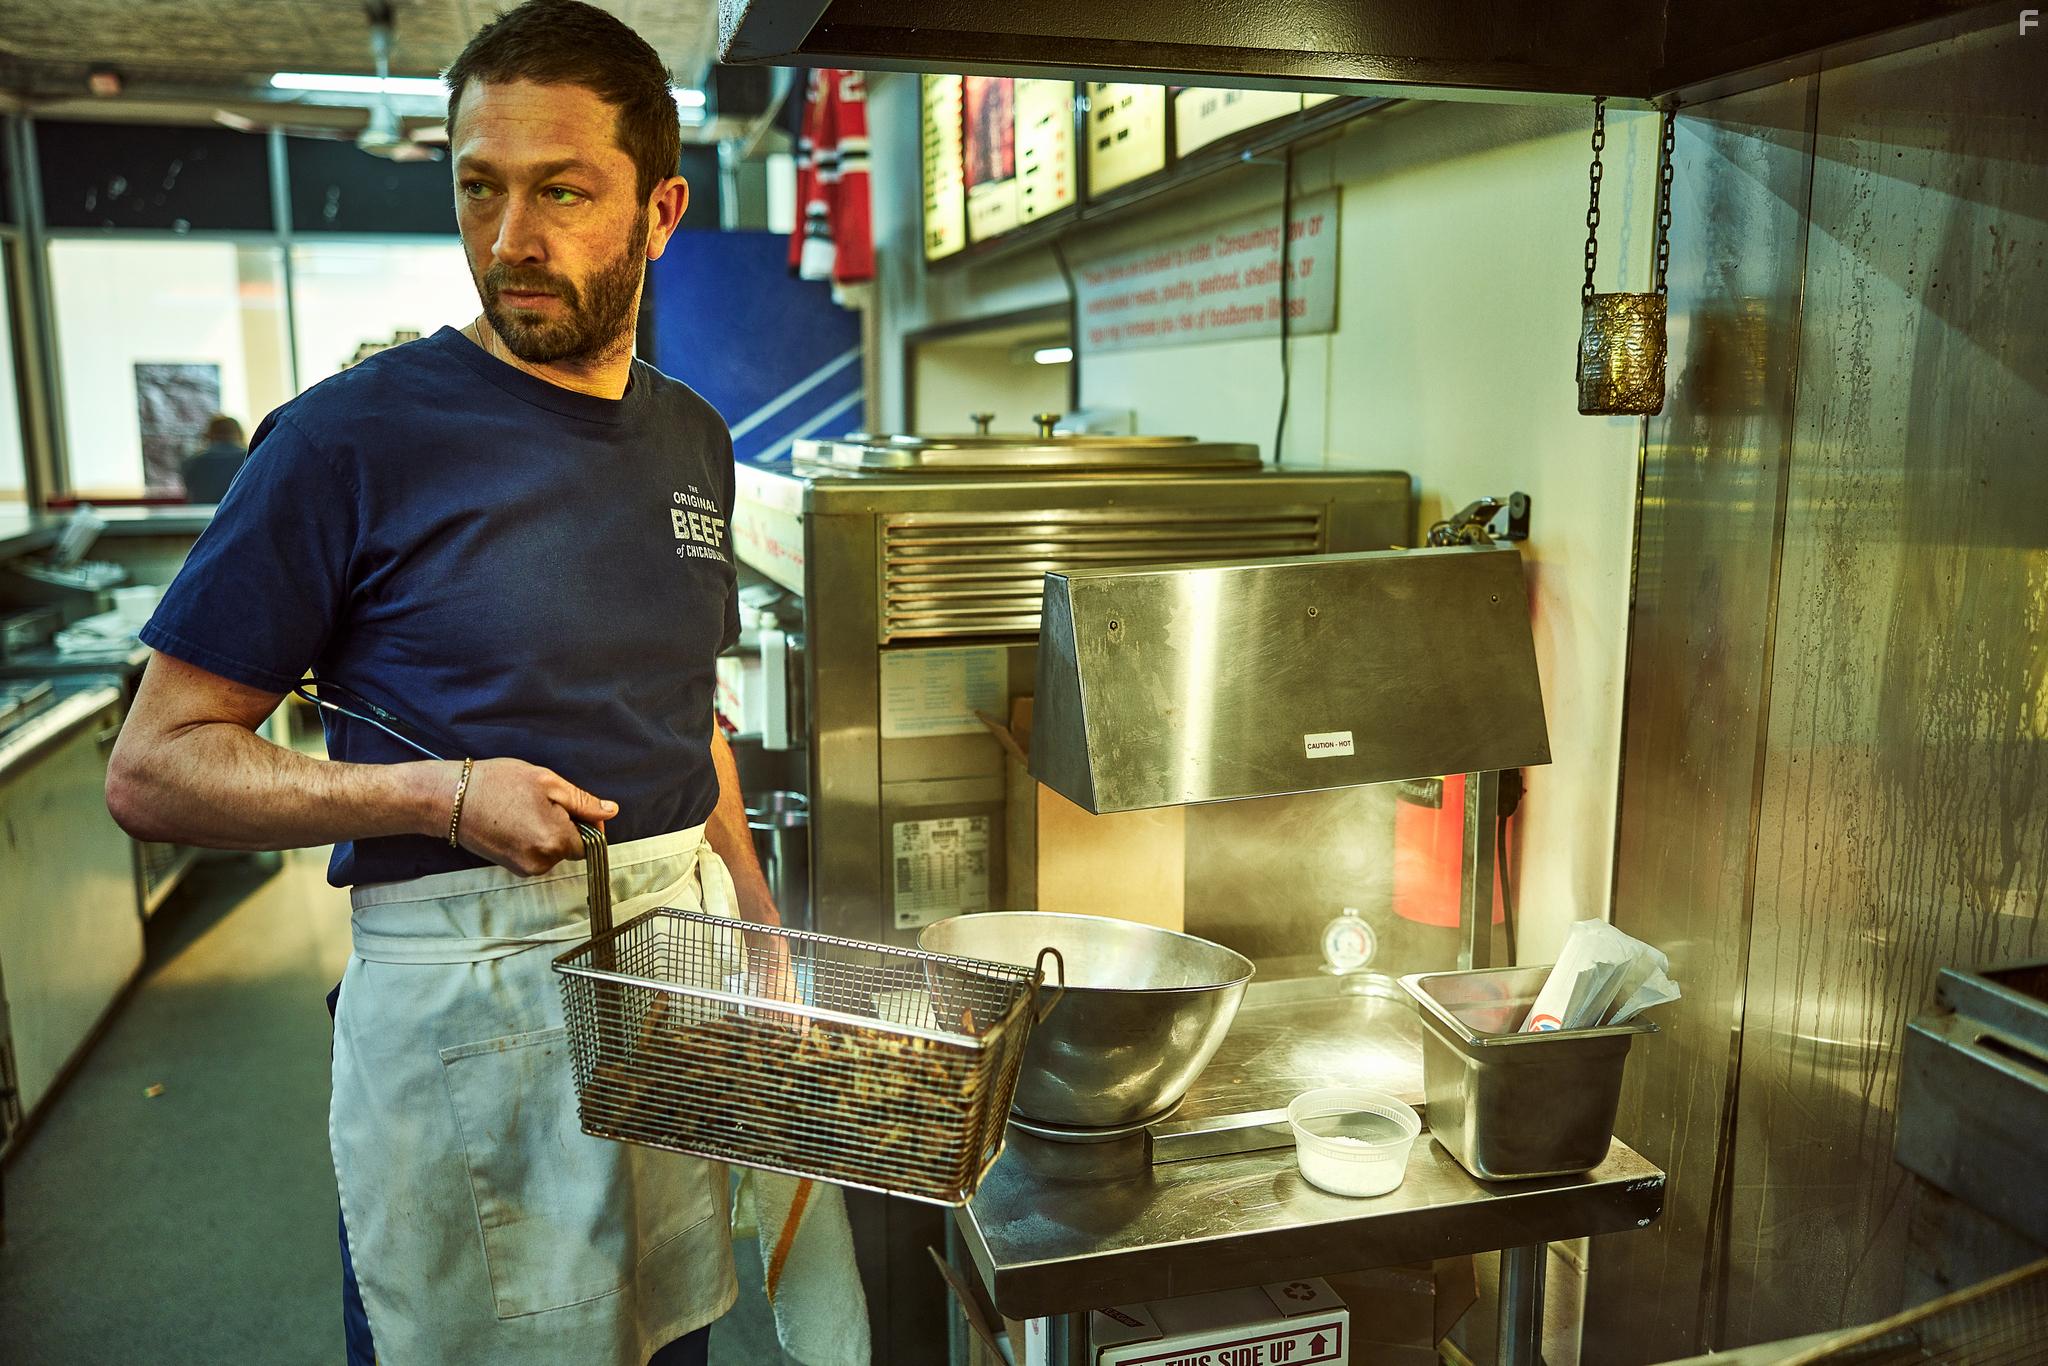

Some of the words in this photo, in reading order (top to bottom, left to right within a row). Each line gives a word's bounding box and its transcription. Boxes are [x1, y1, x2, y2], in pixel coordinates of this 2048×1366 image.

[1215, 225, 1280, 257] Consuming
[1309, 214, 1325, 237] or
[1300, 256, 1315, 279] or
[1210, 301, 1264, 328] foodborne
[687, 484, 699, 494] THE
[673, 491, 718, 513] ORIGINAL
[670, 508, 725, 547] BEEF
[676, 543, 685, 558] of
[1307, 742, 1334, 750] CAUTION
[1217, 1345, 1264, 1366] SIDE
[1269, 1339, 1297, 1364] UP
